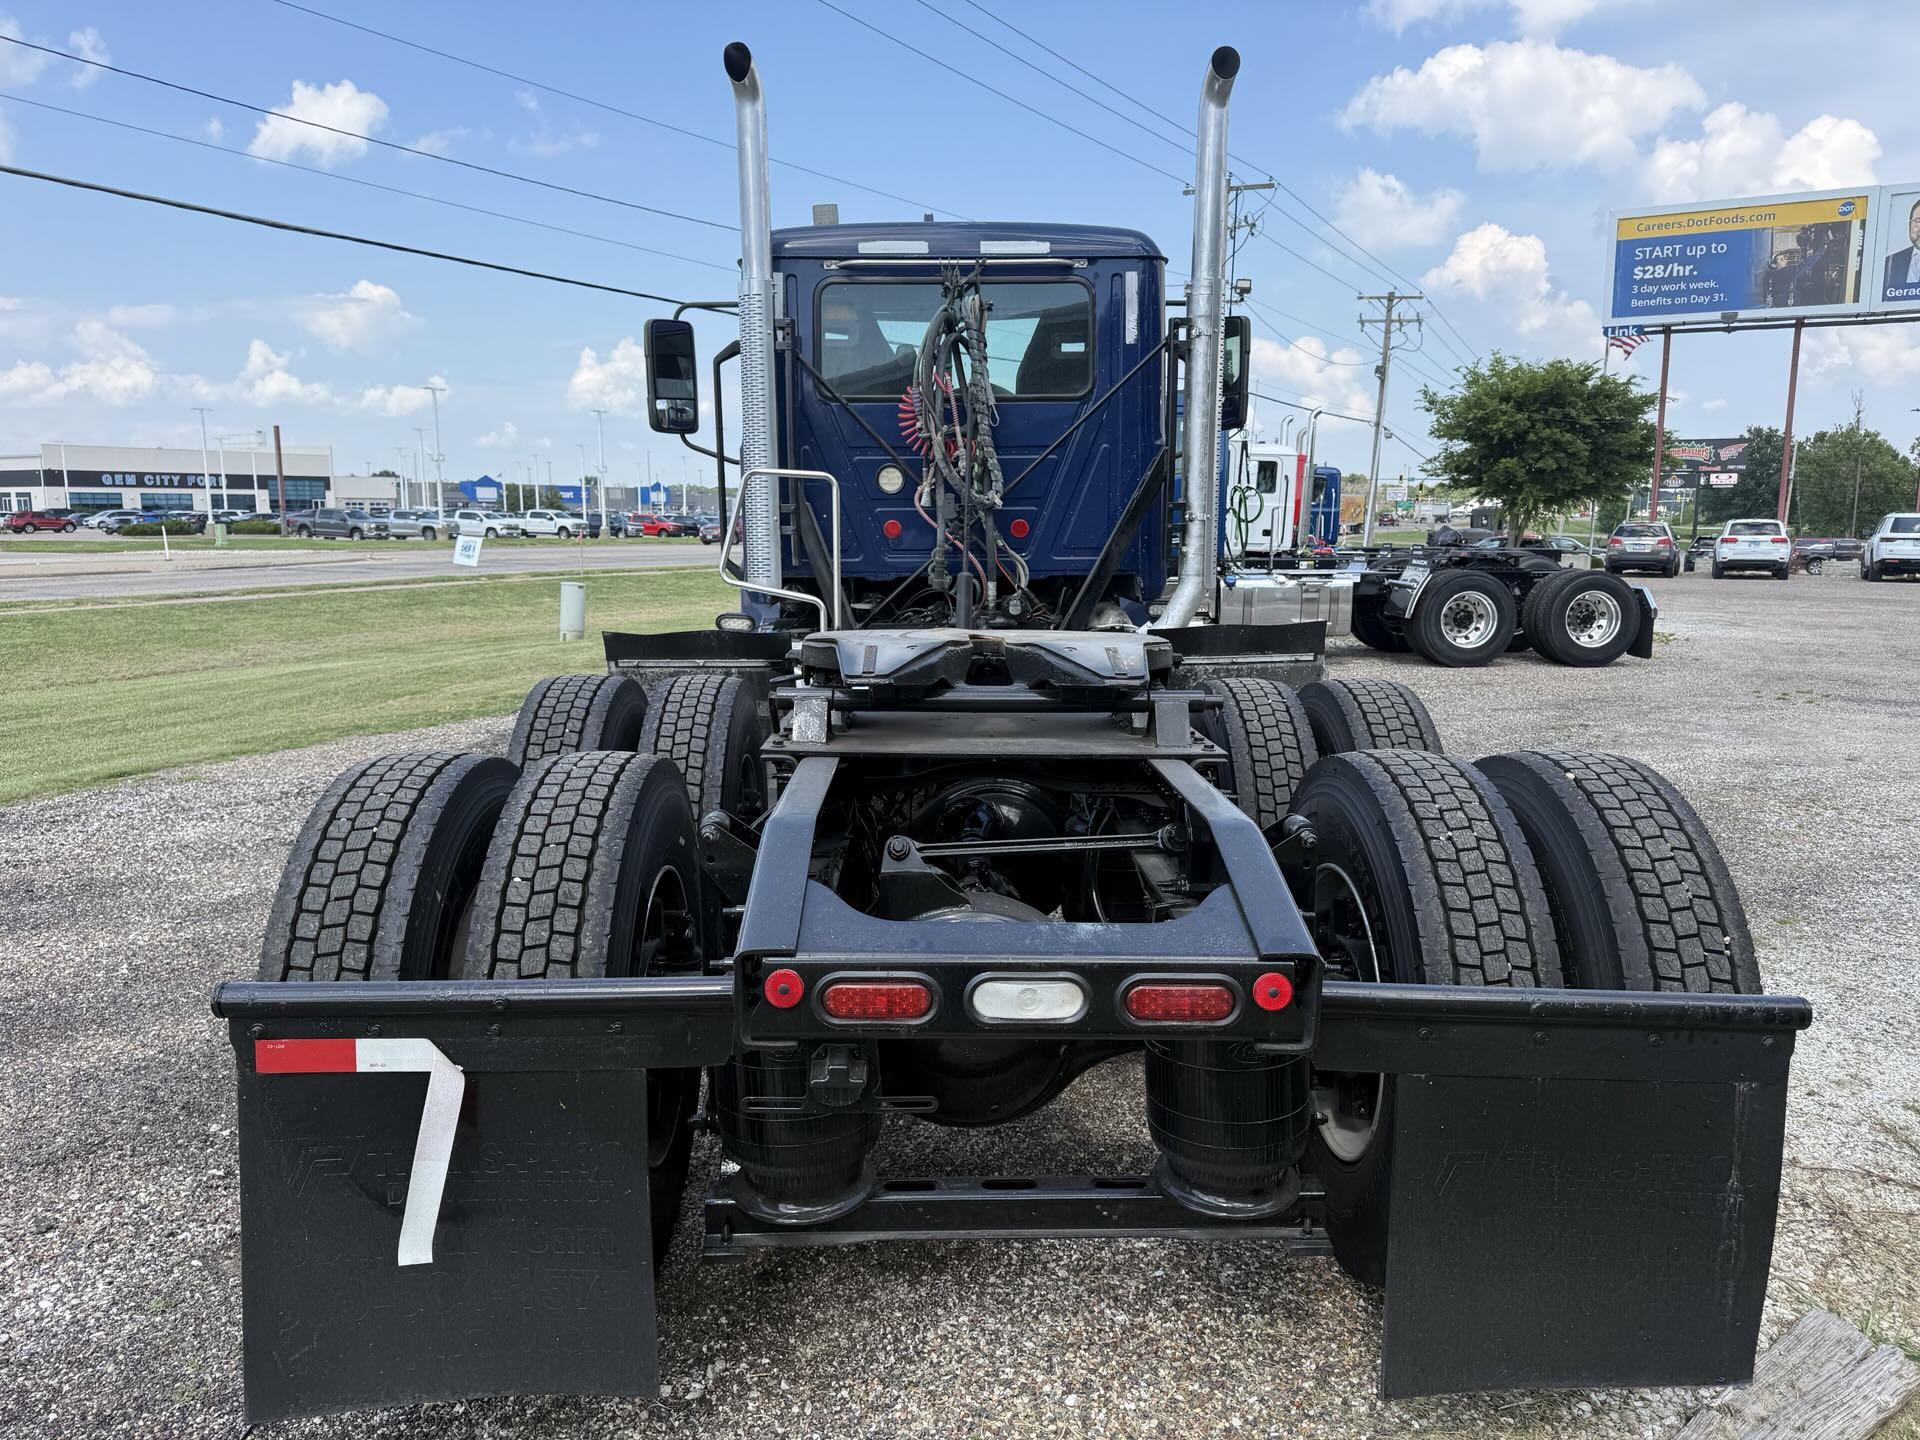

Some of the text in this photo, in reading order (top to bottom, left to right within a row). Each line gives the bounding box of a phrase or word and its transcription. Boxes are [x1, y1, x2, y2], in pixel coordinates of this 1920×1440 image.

[1839, 204, 1855, 213] DOT
[1636, 212, 1776, 233] Careers.DotFoods.com
[1634, 242, 1727, 260] START up to
[1633, 262, 1698, 280] $28/hr.
[1632, 279, 1719, 295] 3 day work week.
[1631, 293, 1728, 307] Benefits on Day 31.
[1608, 325, 1638, 337] Link
[101, 473, 137, 486] GEM
[144, 474, 181, 486] CITY
